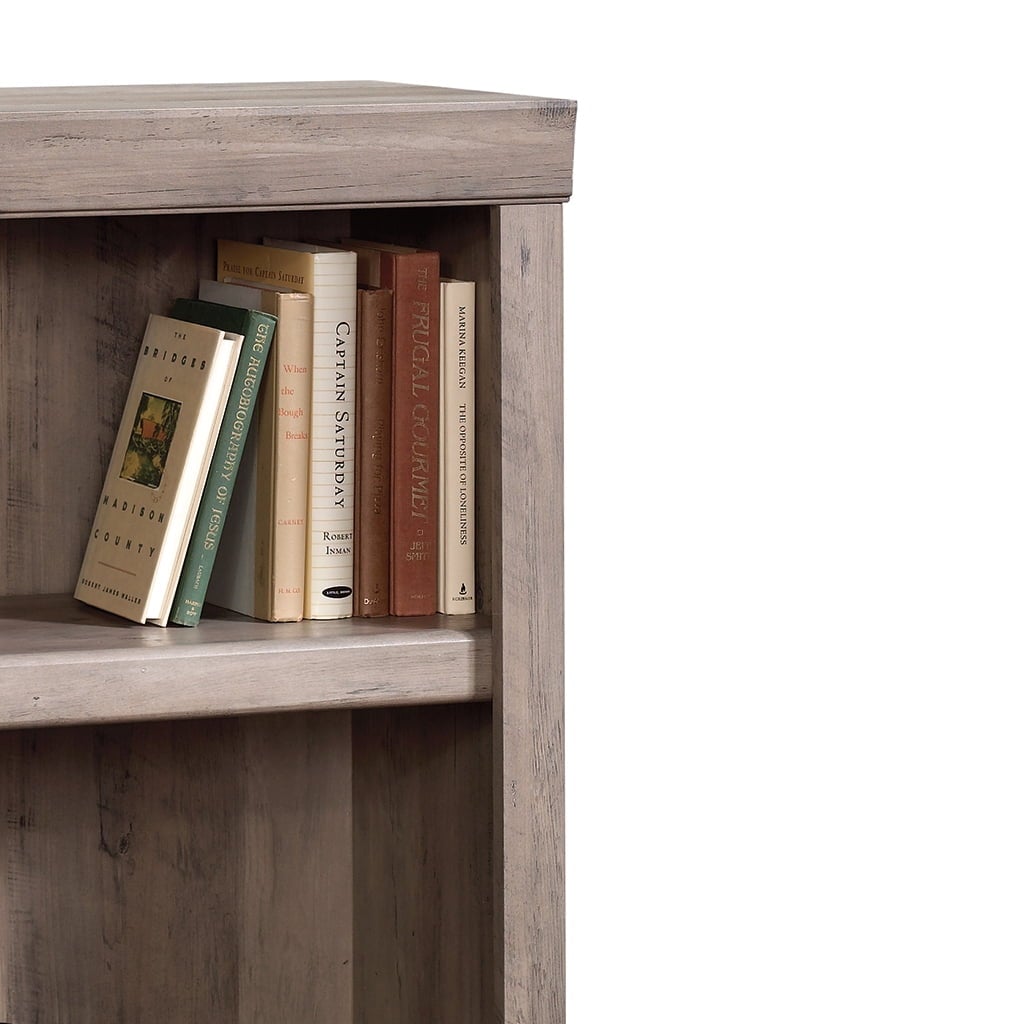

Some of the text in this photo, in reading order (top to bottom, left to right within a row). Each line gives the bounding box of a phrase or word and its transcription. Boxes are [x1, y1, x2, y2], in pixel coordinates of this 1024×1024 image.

[144, 345, 206, 370] BRIDGES
[458, 306, 467, 389] MARINA KEEGAN
[283, 364, 308, 374] When
[280, 386, 295, 396] the
[411, 267, 430, 524] THE FRUGAL GOURMET
[277, 407, 304, 419] Bough
[334, 321, 351, 509] CAPTAIN SATURDAY
[459, 403, 467, 546] THE OPPOSITE OF LONELINESS
[215, 486, 228, 506] OF
[103, 495, 165, 523] MADISON
[203, 507, 224, 551] JESUS
[323, 531, 353, 541] ROBERT
[94, 528, 156, 558] COUNTY
[325, 546, 351, 555] INMAN
[81, 578, 102, 589] ROBERT
[102, 585, 120, 597] JAMES
